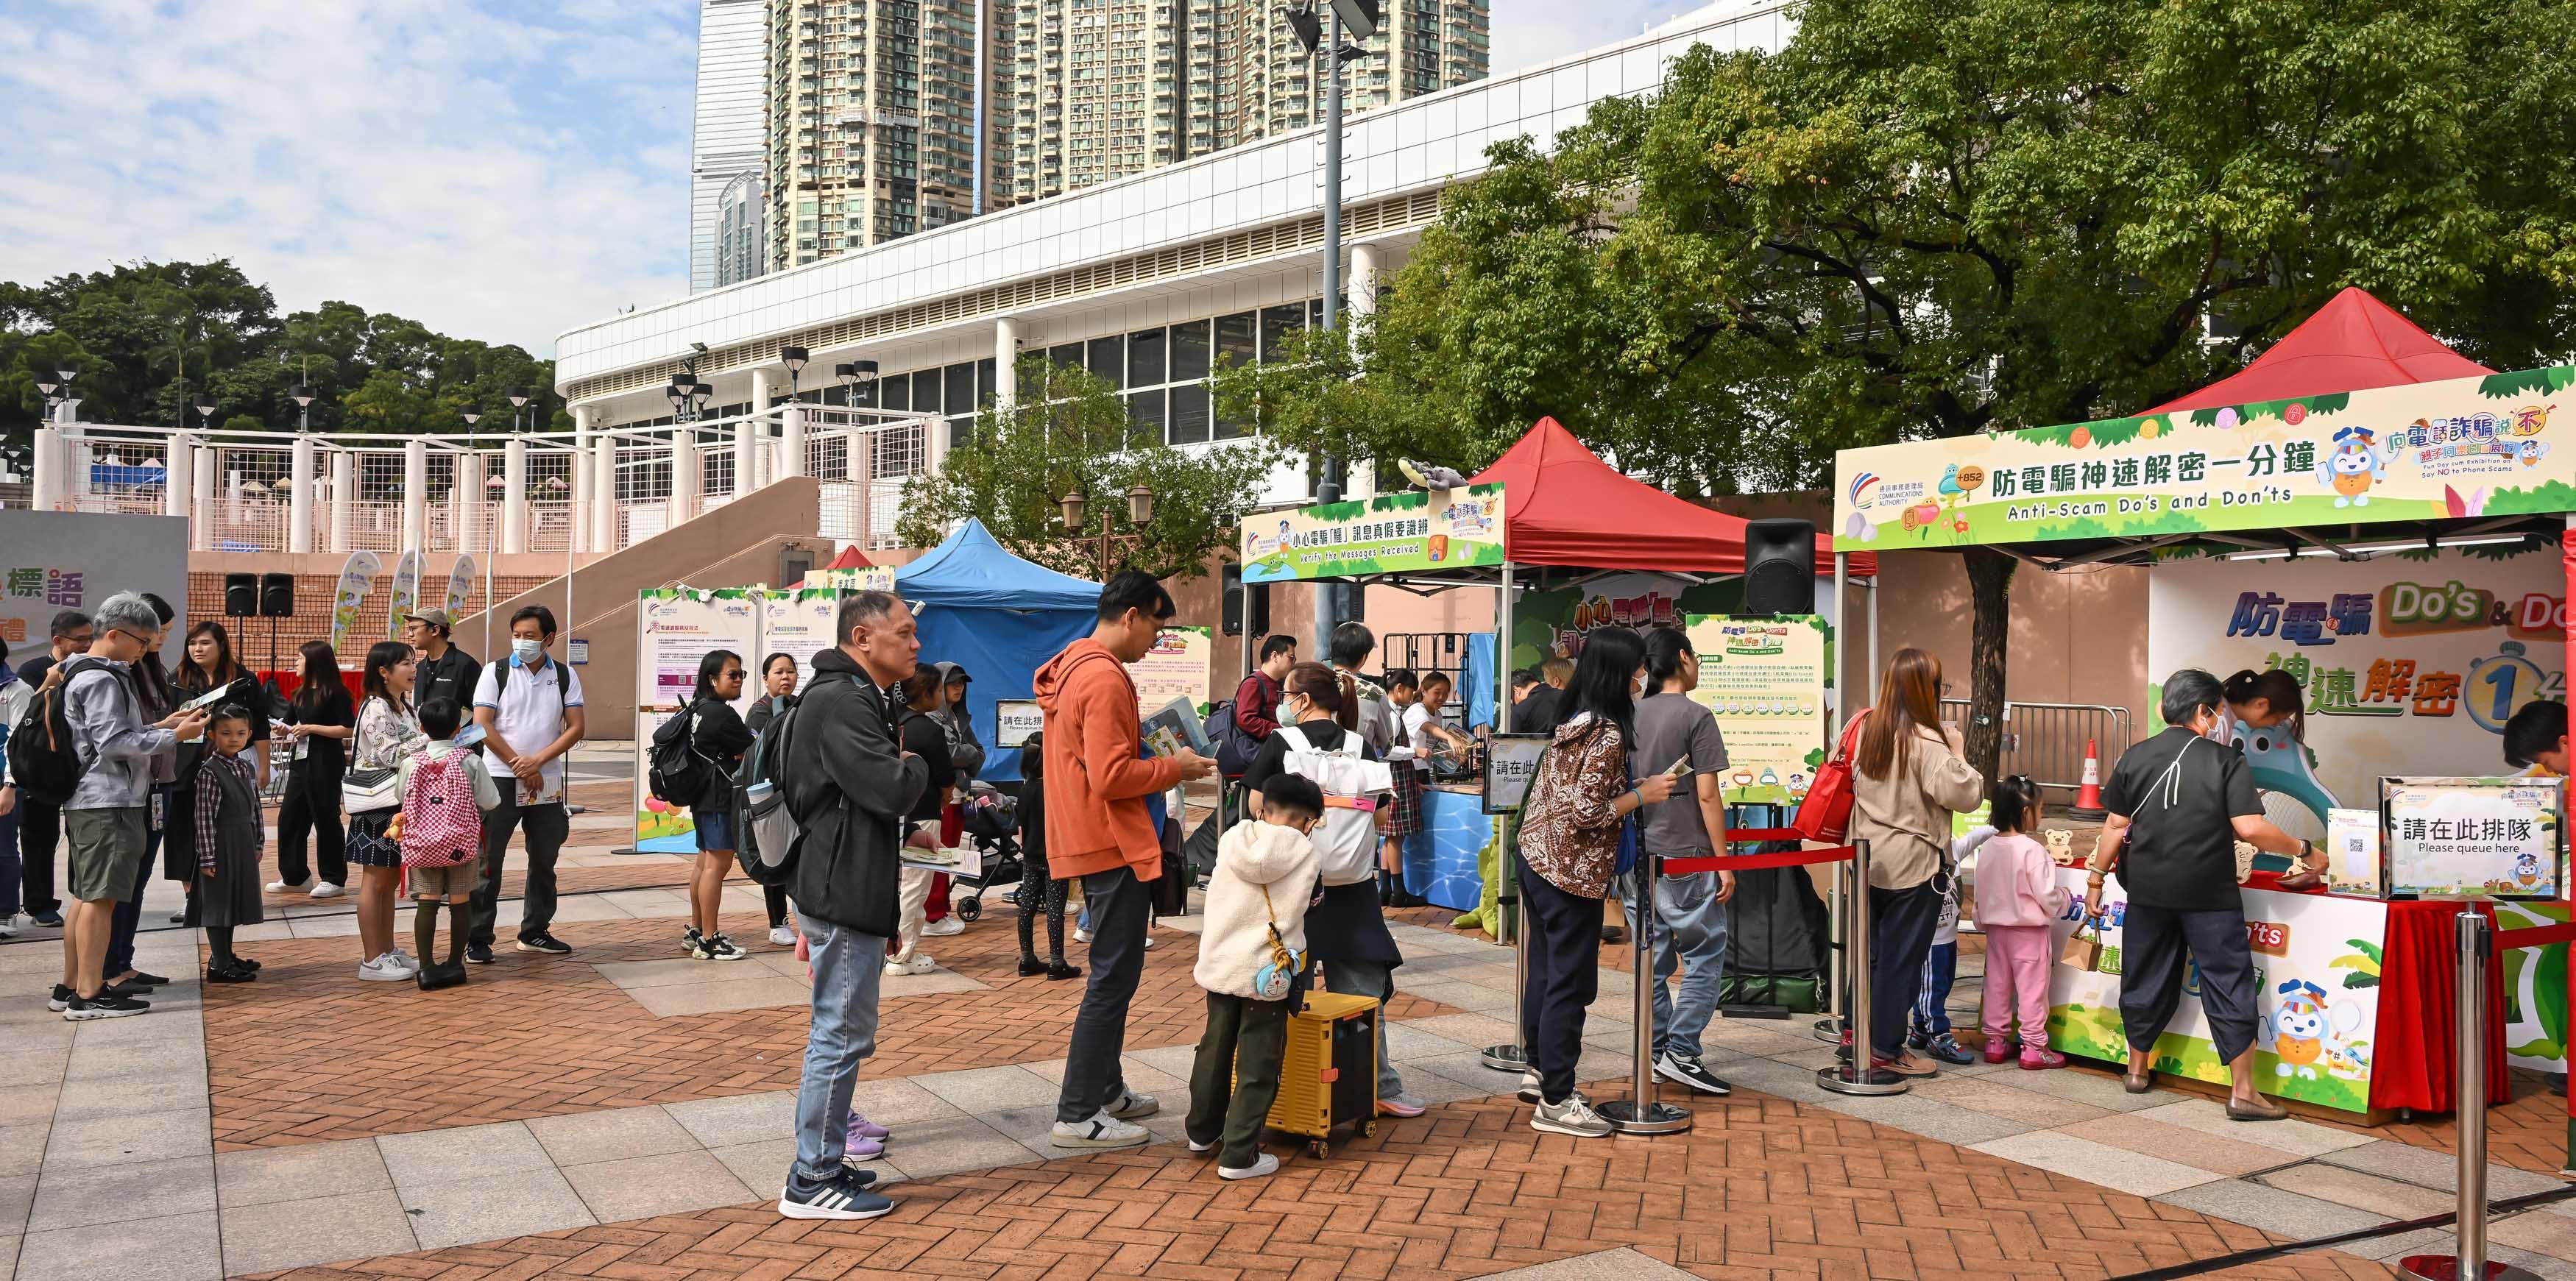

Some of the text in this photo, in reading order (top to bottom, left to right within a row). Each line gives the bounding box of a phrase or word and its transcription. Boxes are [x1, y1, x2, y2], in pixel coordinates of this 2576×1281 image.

[1957, 472, 1982, 483] +852
[1992, 440, 2316, 497] 防電騙神速解密一分鐘
[1879, 491, 1923, 500] COMMUNICATIONS
[1879, 499, 1908, 507] AUTHORITY
[2007, 484, 2291, 520] Anti-Scam Do's and Don'ts
[1300, 543, 1419, 563] Verify the Messages Received
[0, 568, 84, 608] 標語
[2226, 591, 2374, 646] 防電騙
[2391, 583, 2480, 620] Do's
[2488, 600, 2513, 626] &
[1496, 760, 1535, 776] 請在此
[2402, 817, 2532, 842] 請在此排隊
[2418, 842, 2520, 856] Please queue here
